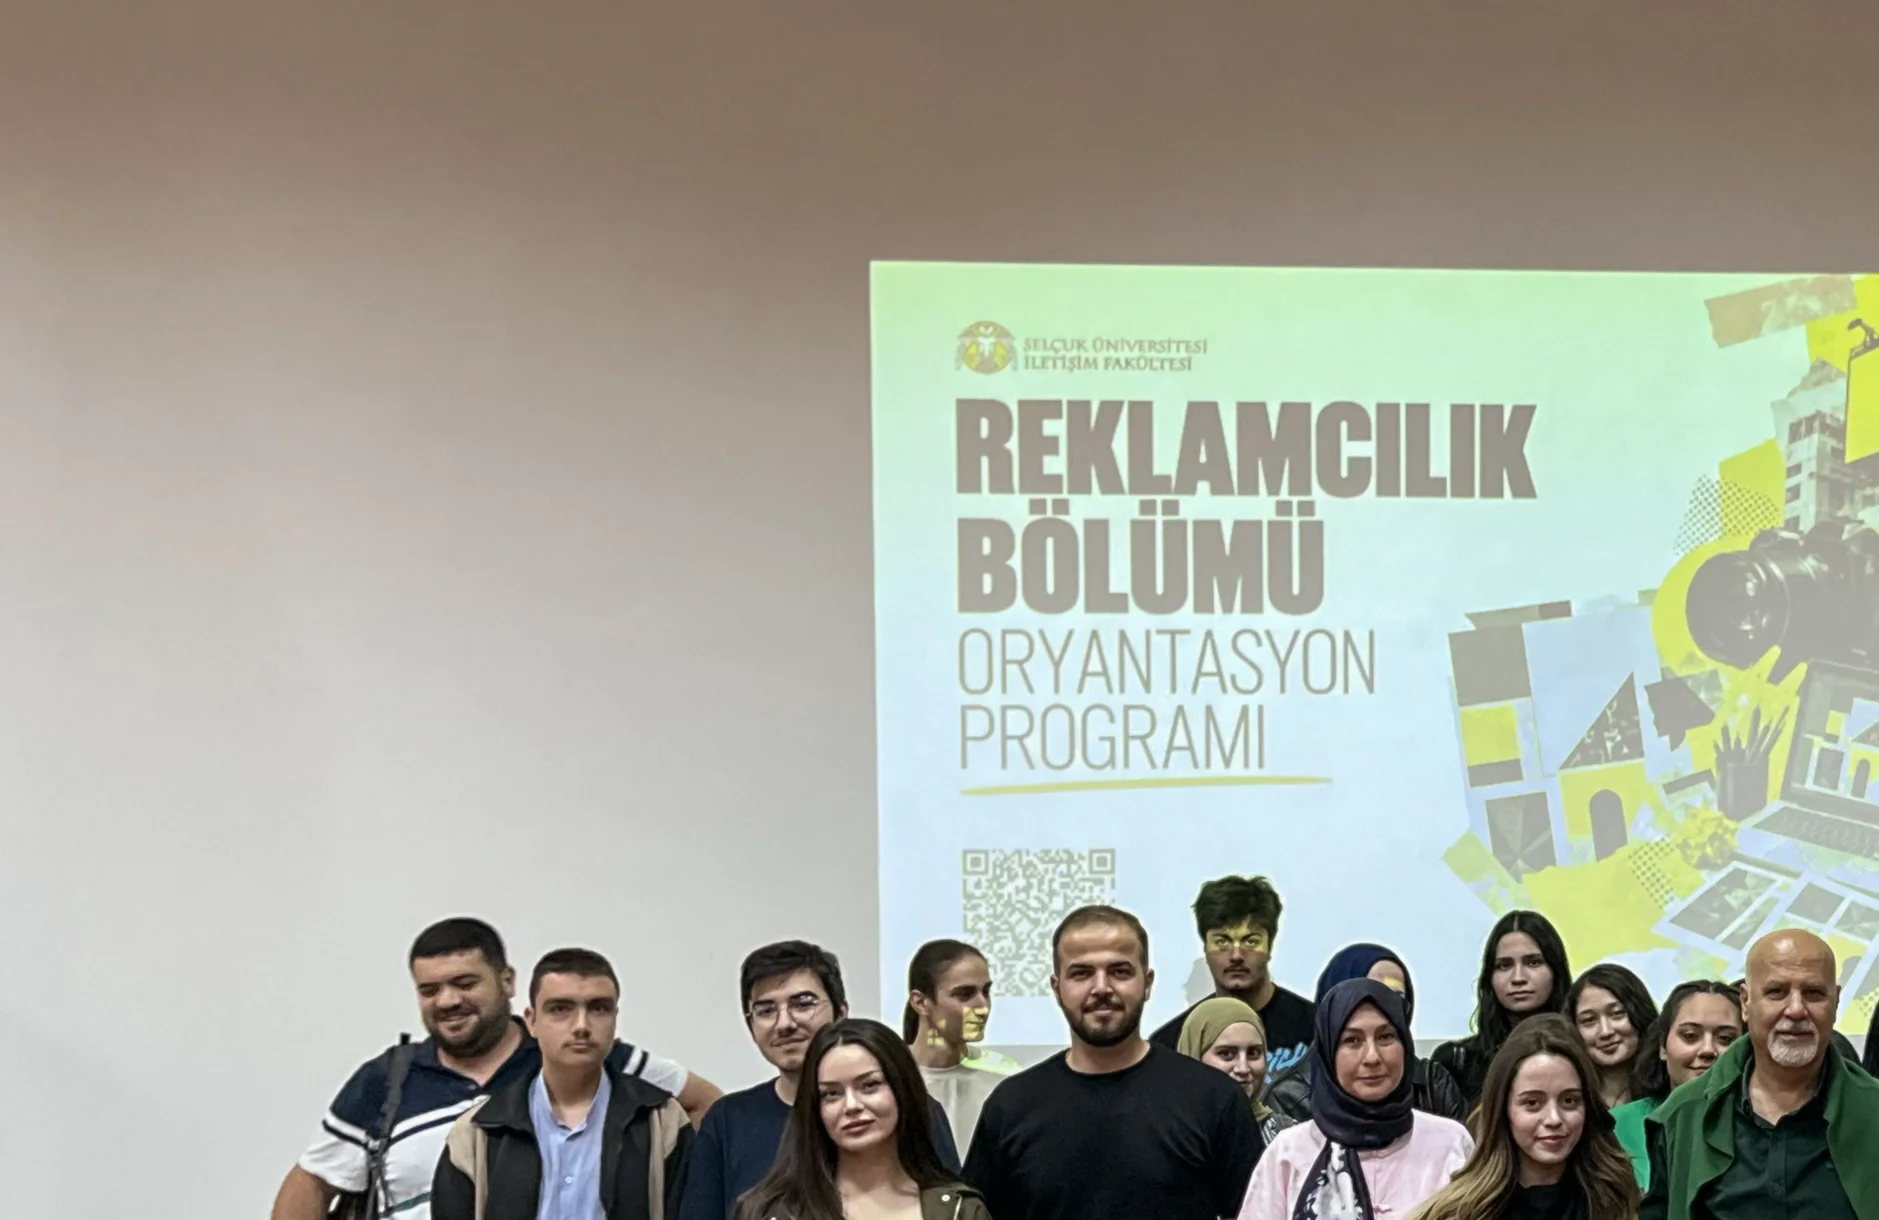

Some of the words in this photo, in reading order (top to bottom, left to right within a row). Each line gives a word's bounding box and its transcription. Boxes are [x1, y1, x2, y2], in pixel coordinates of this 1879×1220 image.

[1023, 337, 1088, 357] SELÇUK
[955, 397, 1538, 500] REKLAMCILIK
[956, 498, 1325, 615] BÖLÜMÜ
[958, 627, 1376, 696] ORYANTASYON
[959, 703, 1266, 771] PROGRAMI
